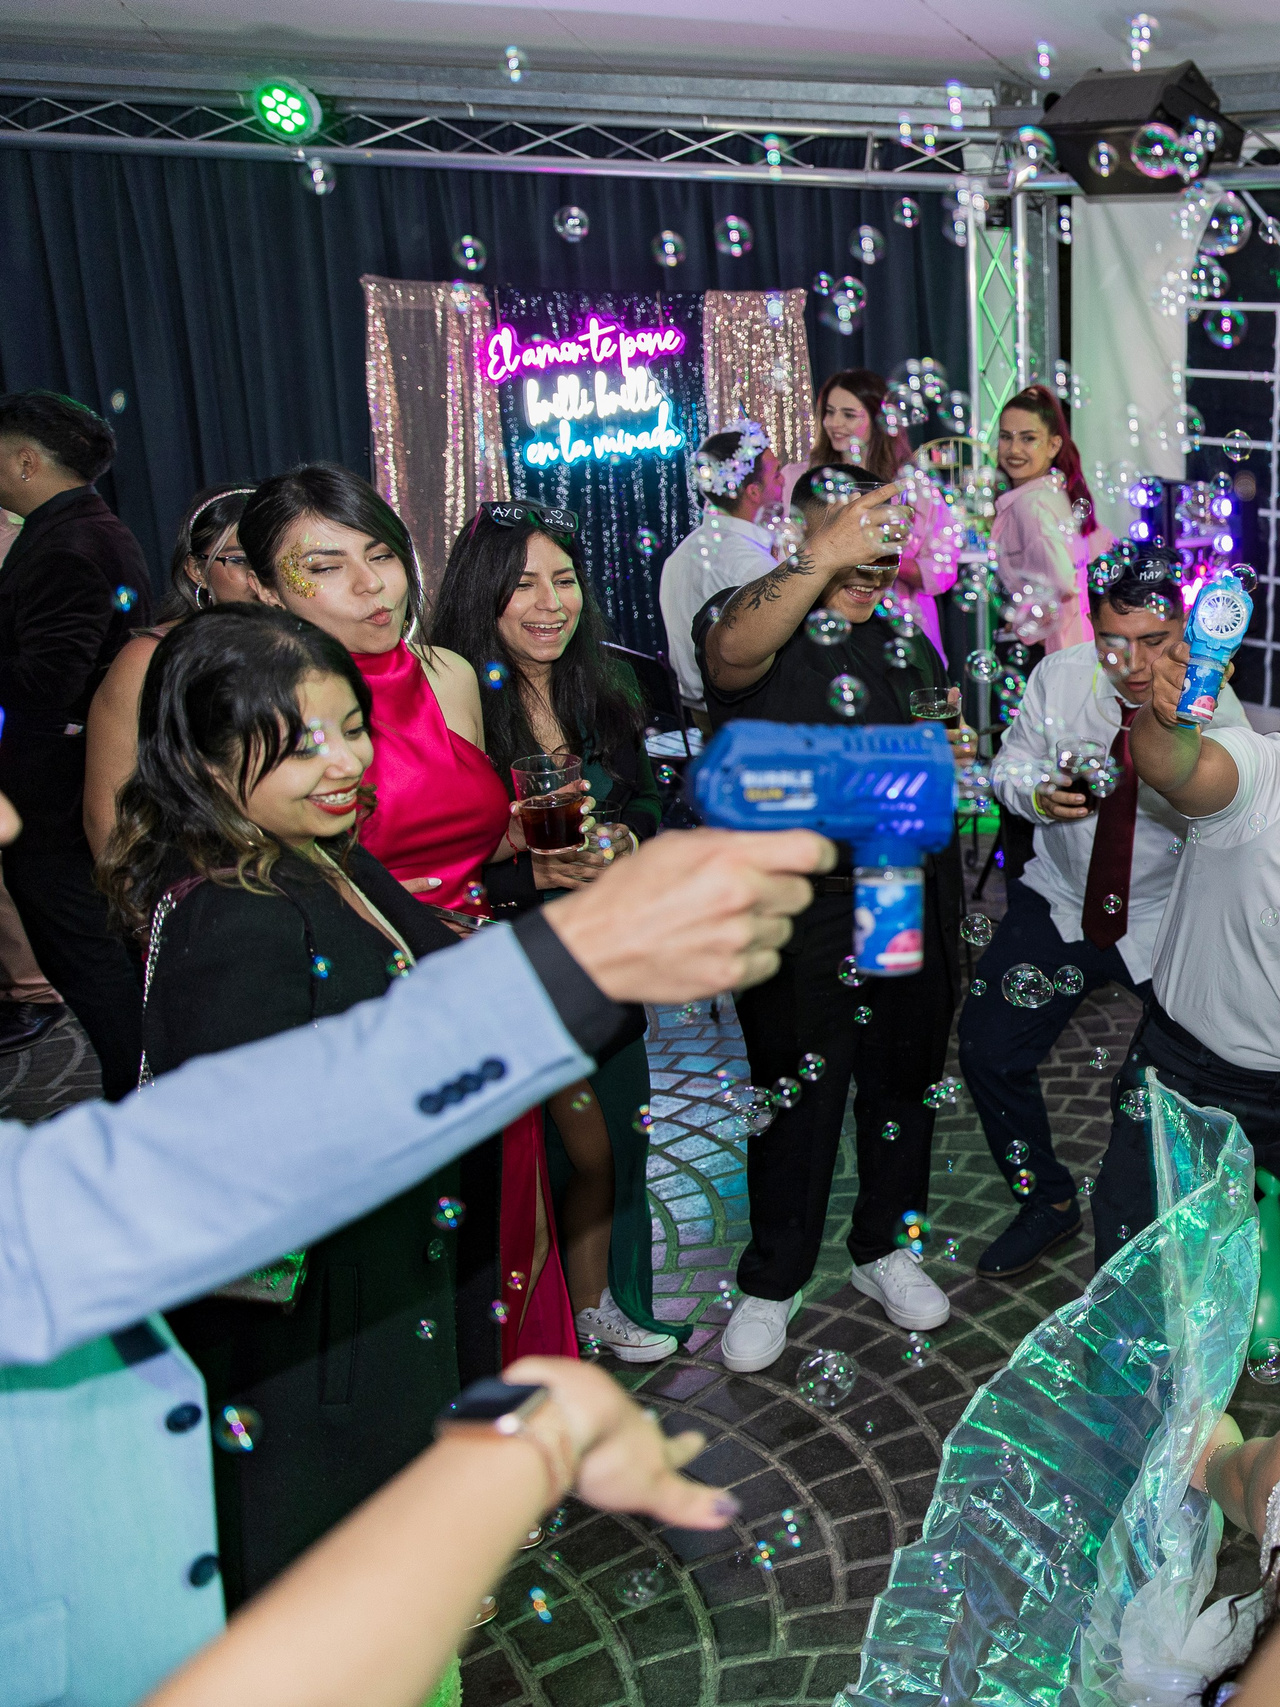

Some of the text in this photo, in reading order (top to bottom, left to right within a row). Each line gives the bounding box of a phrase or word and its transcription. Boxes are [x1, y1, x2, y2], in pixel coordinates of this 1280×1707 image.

[487, 317, 681, 381] El amor te pone
[526, 401, 682, 465] en la mirada
[1139, 571, 1162, 581] MAY
